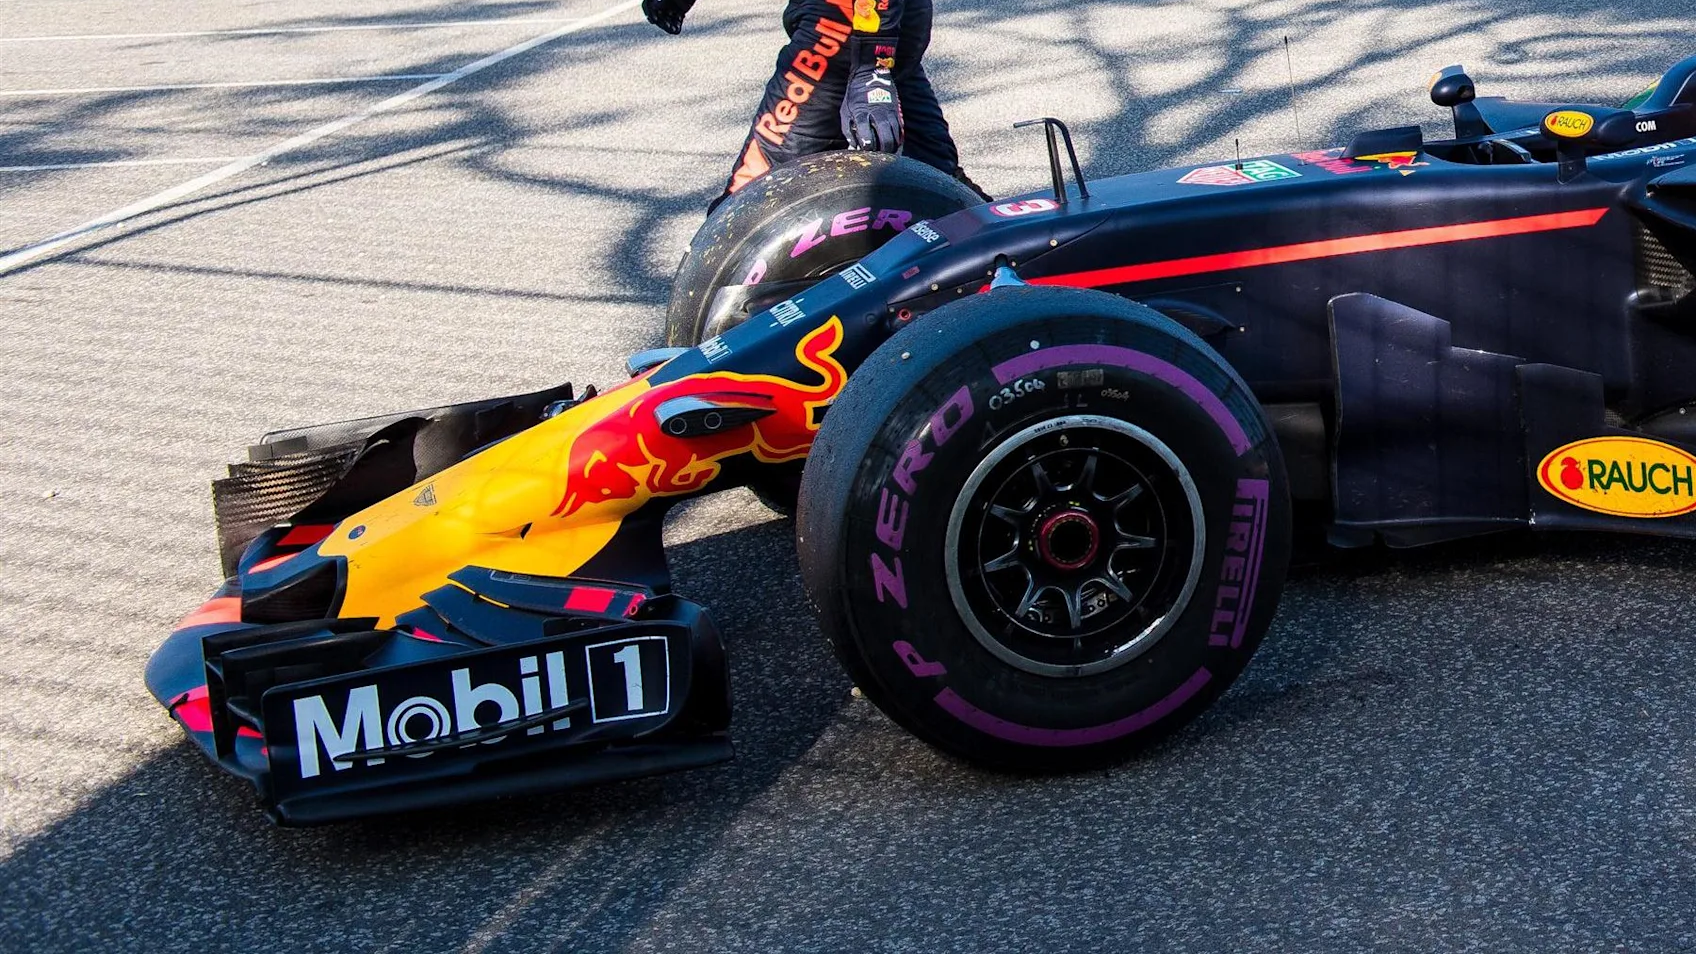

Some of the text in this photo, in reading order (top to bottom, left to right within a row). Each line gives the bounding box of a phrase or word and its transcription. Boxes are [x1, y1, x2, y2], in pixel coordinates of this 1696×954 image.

[755, 17, 852, 146] Red Bull
[1557, 116, 1587, 130] RAUCH
[769, 298, 807, 327] CITRIX
[839, 262, 877, 290] PIRELLI
[1588, 459, 1693, 496] RAUCH
[868, 384, 976, 677] P ZERO
[1208, 478, 1269, 649] PIRELLI
[293, 644, 646, 779] Mobil 1
